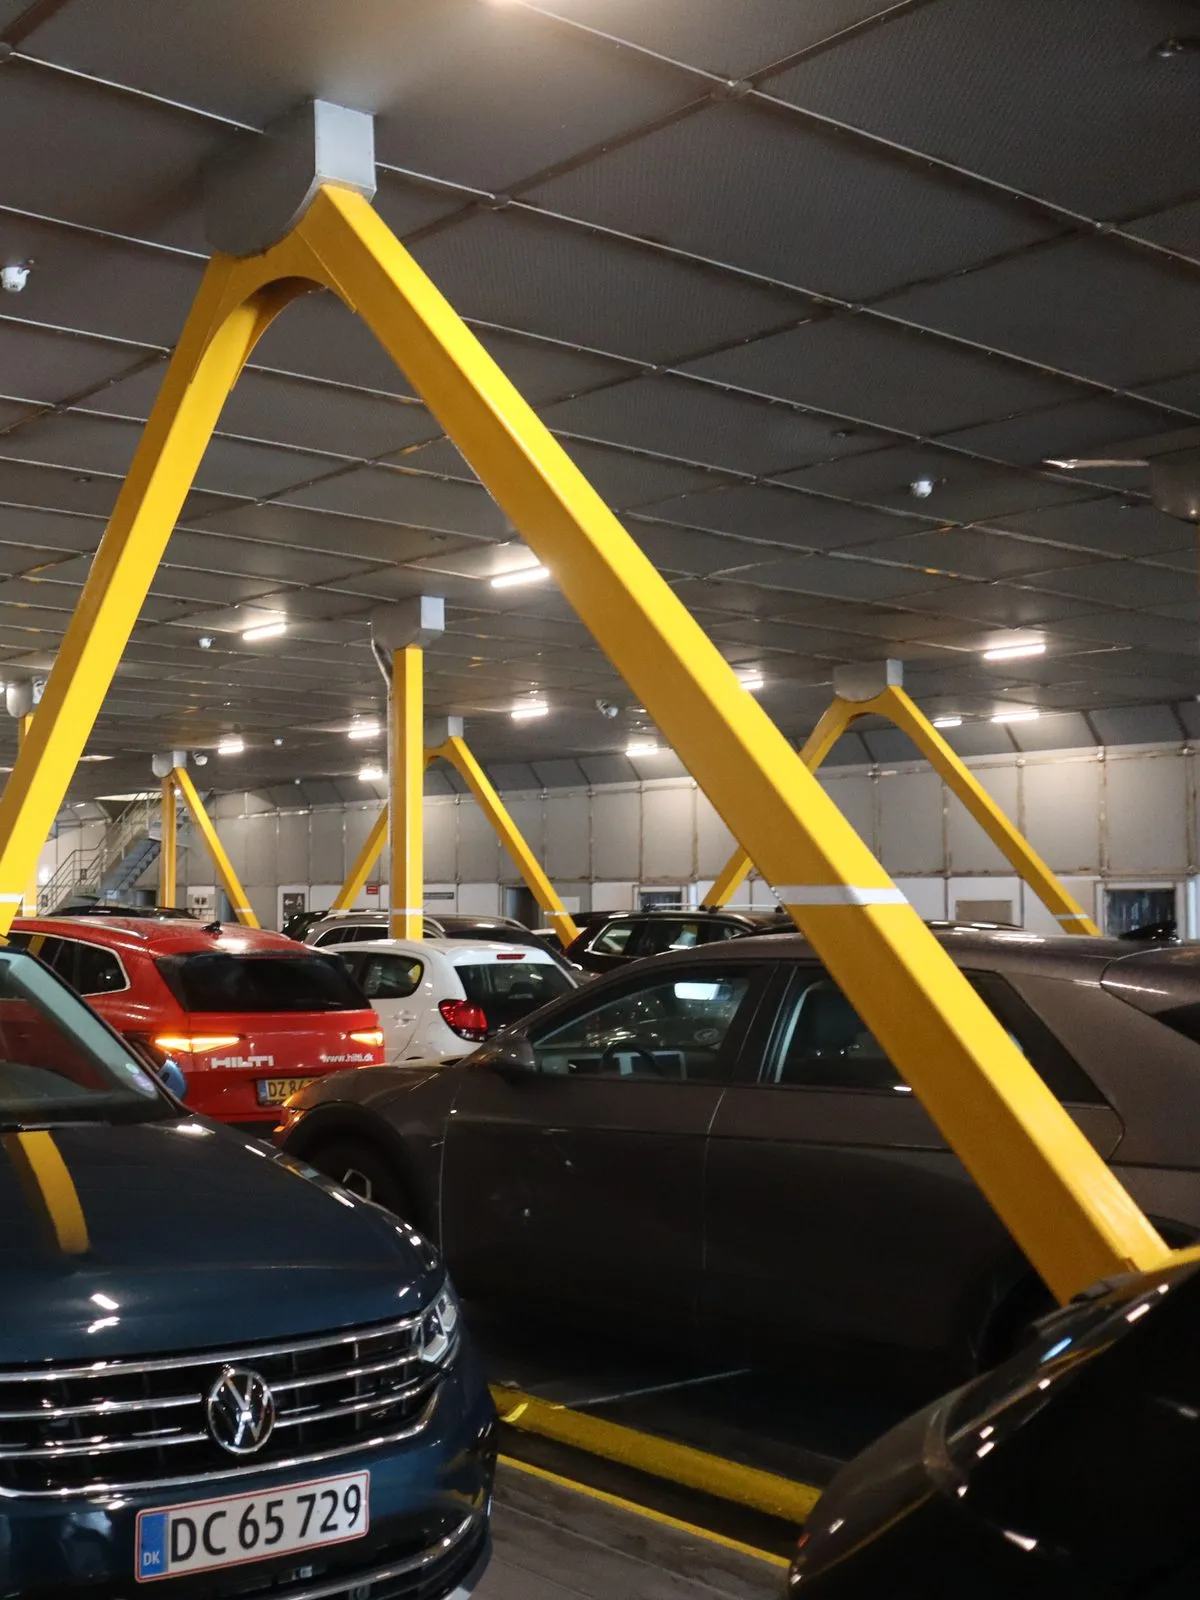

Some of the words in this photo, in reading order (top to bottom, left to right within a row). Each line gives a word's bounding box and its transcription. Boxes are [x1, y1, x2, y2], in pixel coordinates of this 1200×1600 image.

[211, 1055, 274, 1069] HILTI
[268, 1081, 286, 1097] DZ
[170, 1510, 227, 1563] DC
[238, 1499, 285, 1550] 65
[296, 1484, 362, 1538] 729
[143, 1551, 161, 1567] DK
